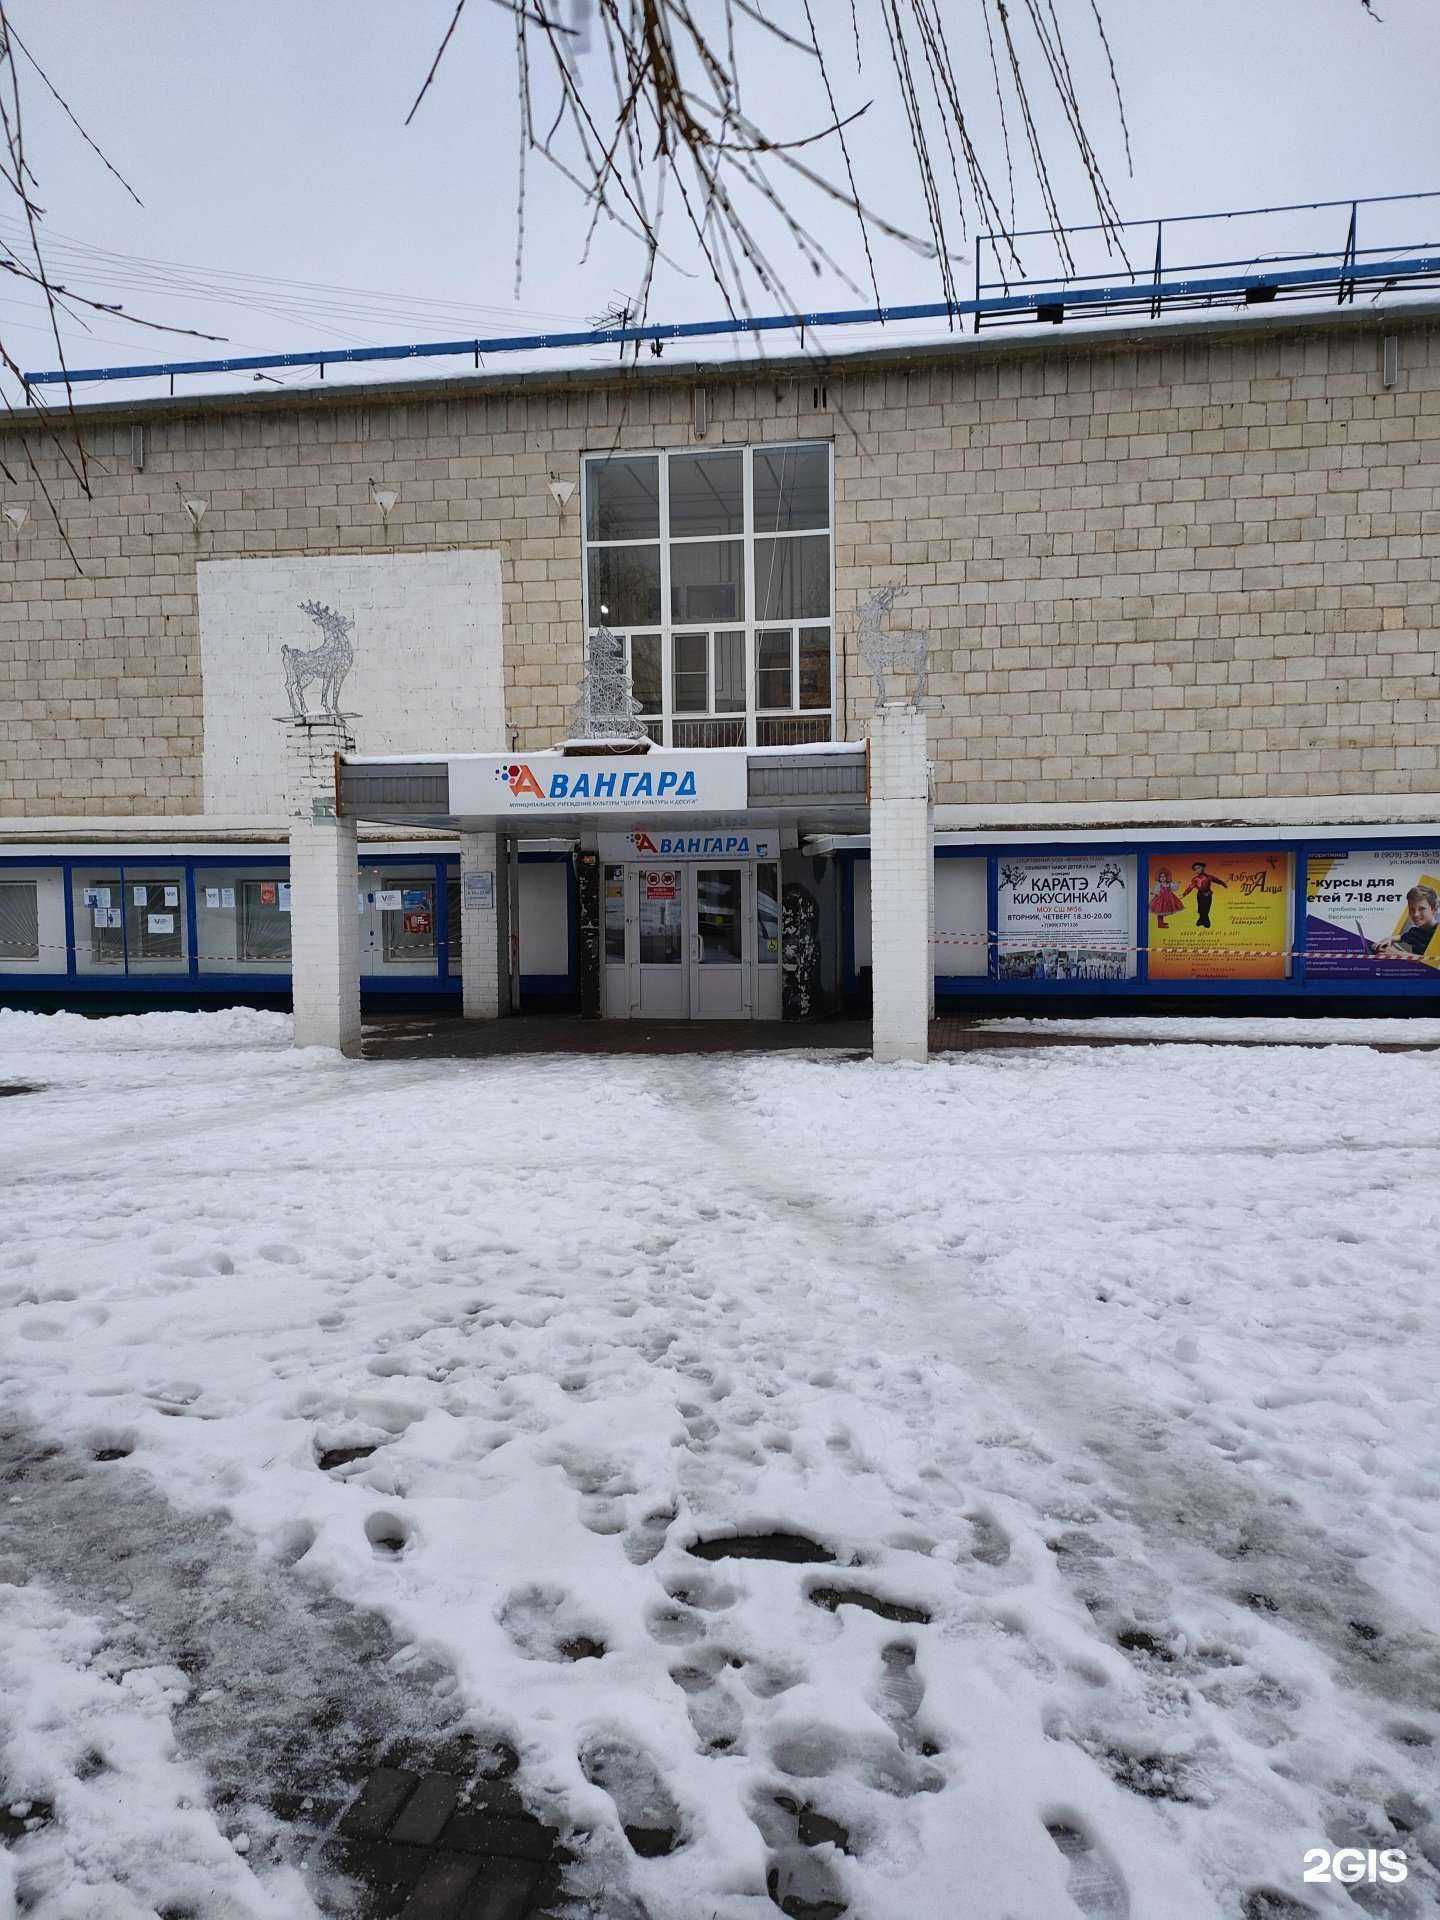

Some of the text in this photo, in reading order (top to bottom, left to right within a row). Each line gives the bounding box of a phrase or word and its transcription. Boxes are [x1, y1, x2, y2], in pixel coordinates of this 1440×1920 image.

[509, 765, 697, 798] АВАНГАРД
[635, 833, 750, 853] АВАНГАРД
[1031, 877, 1089, 891] КАРАТЭ
[1366, 878, 1395, 888] для
[1013, 890, 1108, 905] КИОКУСИНКАЙ
[1306, 892, 1403, 903] етей 7-18 лет
[1036, 905, 1052, 913] МОУ
[1053, 905, 1065, 913] СШ
[1074, 912, 1112, 920] 18.30-20.00
